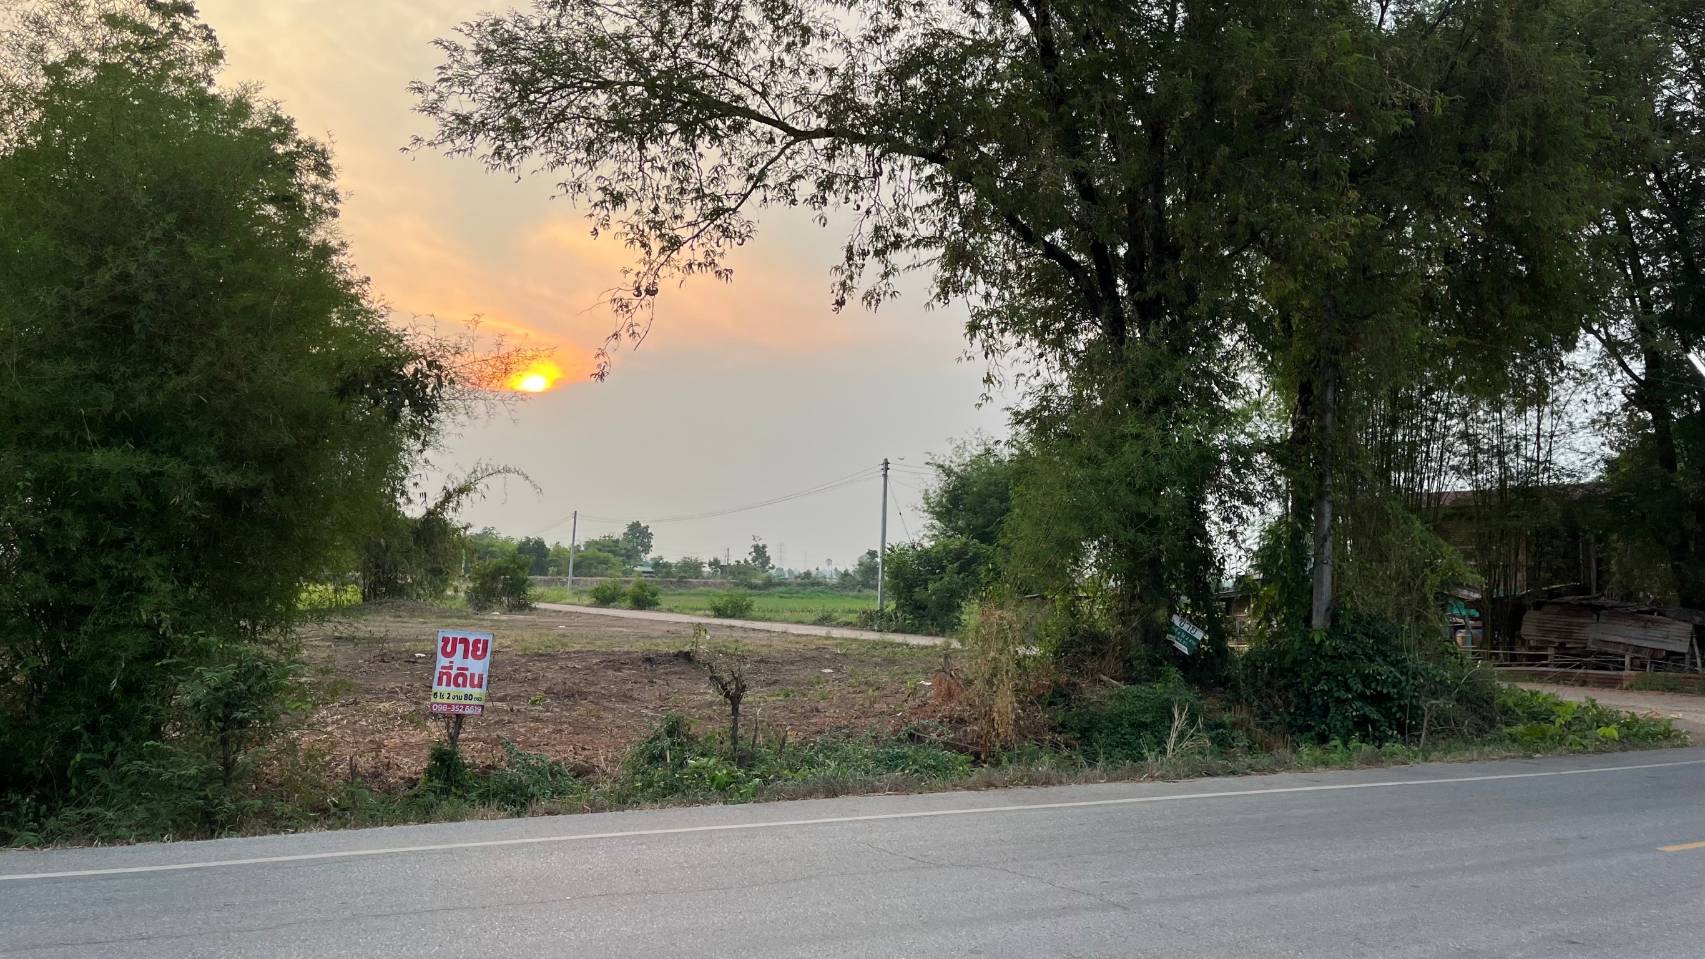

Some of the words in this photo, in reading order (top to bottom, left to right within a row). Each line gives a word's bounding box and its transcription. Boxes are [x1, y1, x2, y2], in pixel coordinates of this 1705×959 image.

[440, 636, 489, 660] ขาย
[437, 660, 484, 688] ที่ดิน
